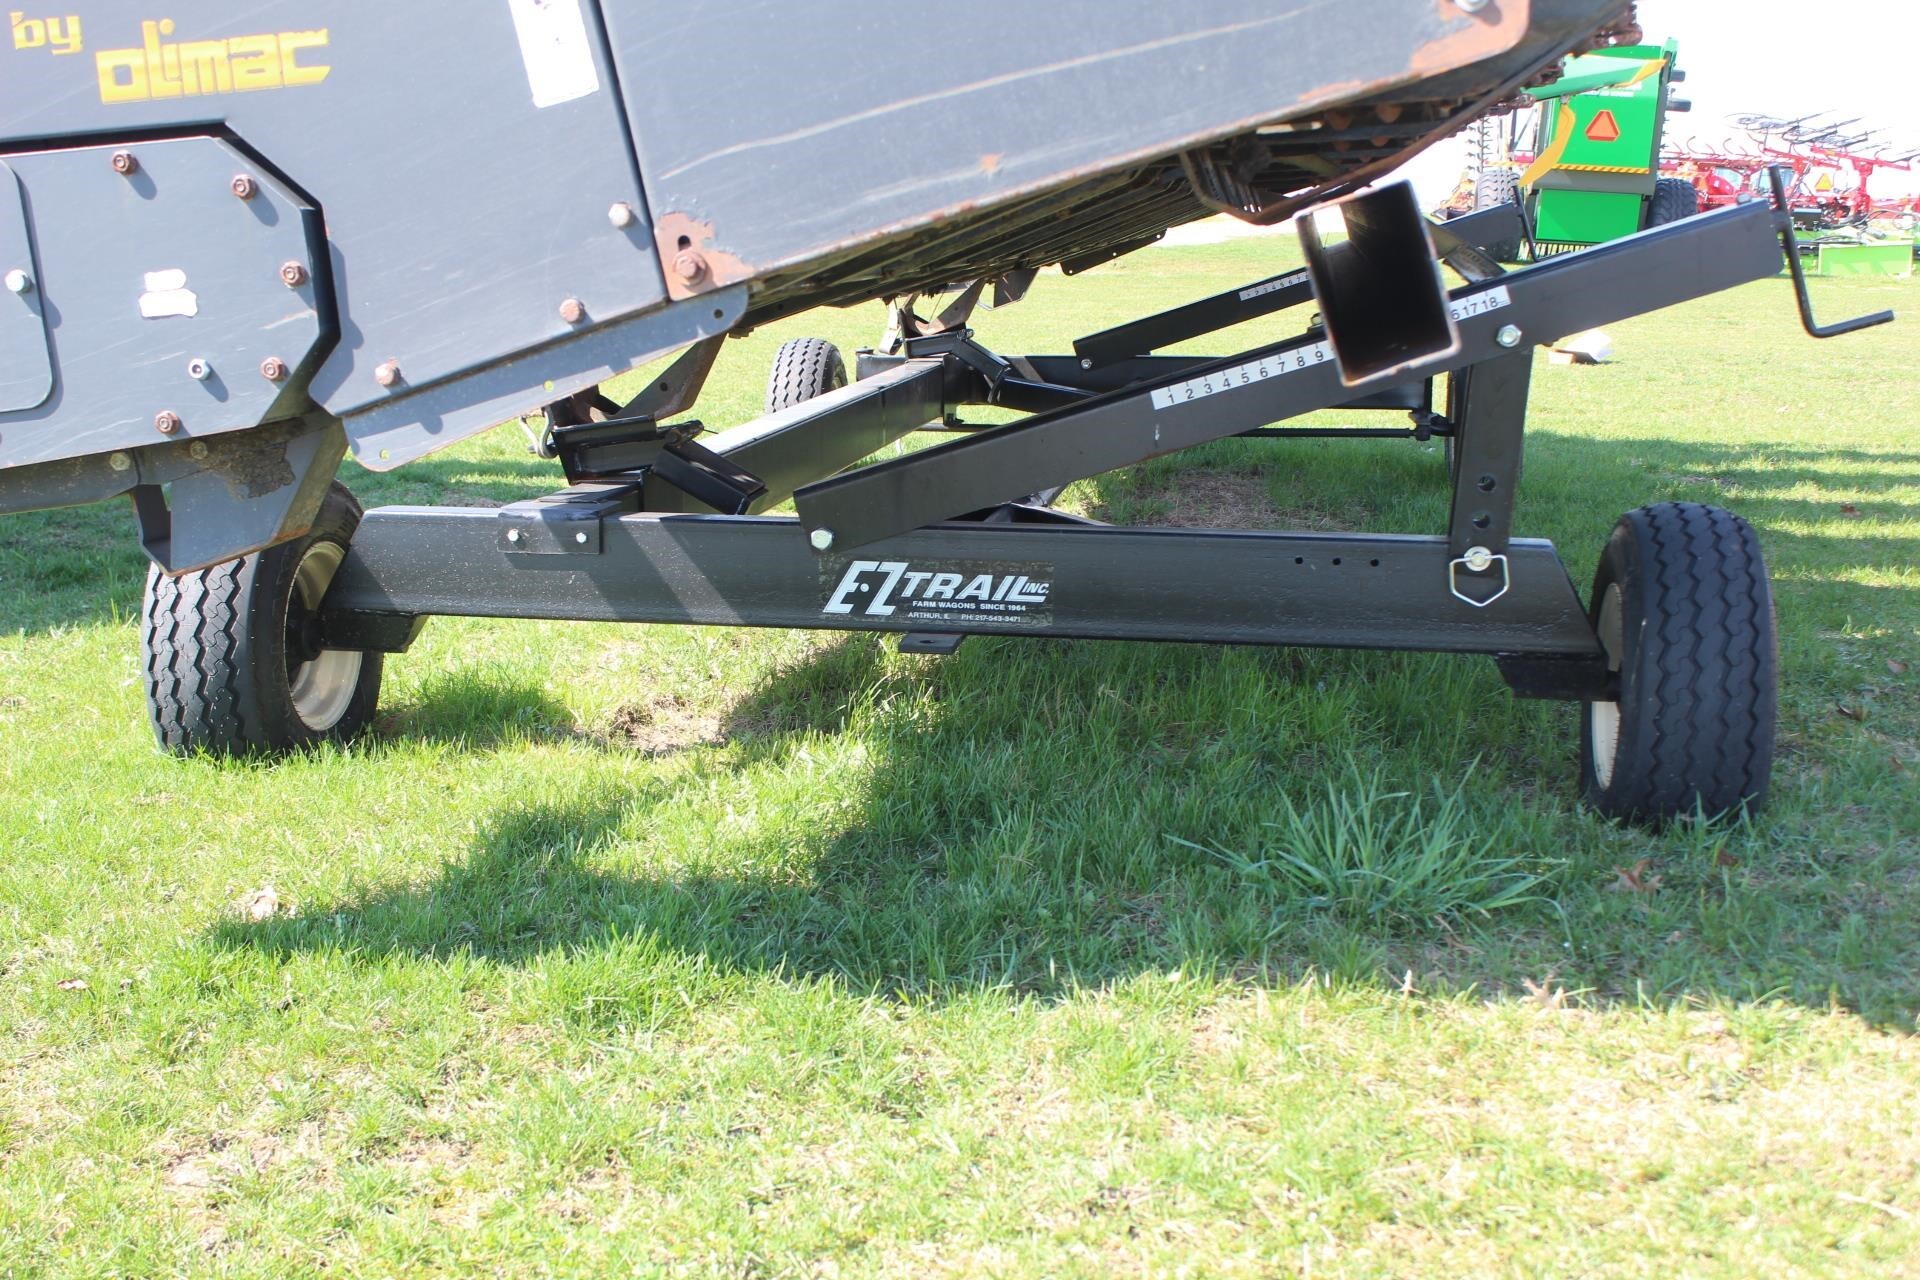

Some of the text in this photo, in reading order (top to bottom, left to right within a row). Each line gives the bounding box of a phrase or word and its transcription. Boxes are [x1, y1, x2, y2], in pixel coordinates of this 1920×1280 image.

[10, 11, 83, 55] by
[96, 18, 331, 104] olimac
[1168, 394, 1175, 404] 1
[1185, 388, 1194, 400] 2
[1204, 383, 1213, 394] 3
[1223, 378, 1231, 388] 4
[1241, 373, 1250, 383] 5
[1259, 367, 1268, 378] 6
[1278, 361, 1286, 372] 7
[1296, 356, 1305, 367] 8
[1315, 350, 1324, 361] 9
[1462, 302, 1478, 316] 17
[1482, 296, 1498, 310] 18
[901, 571, 1047, 603] TRAIL
[1022, 582, 1050, 595] INC.
[912, 600, 1026, 612] FARM WAGONS SINCE 1964
